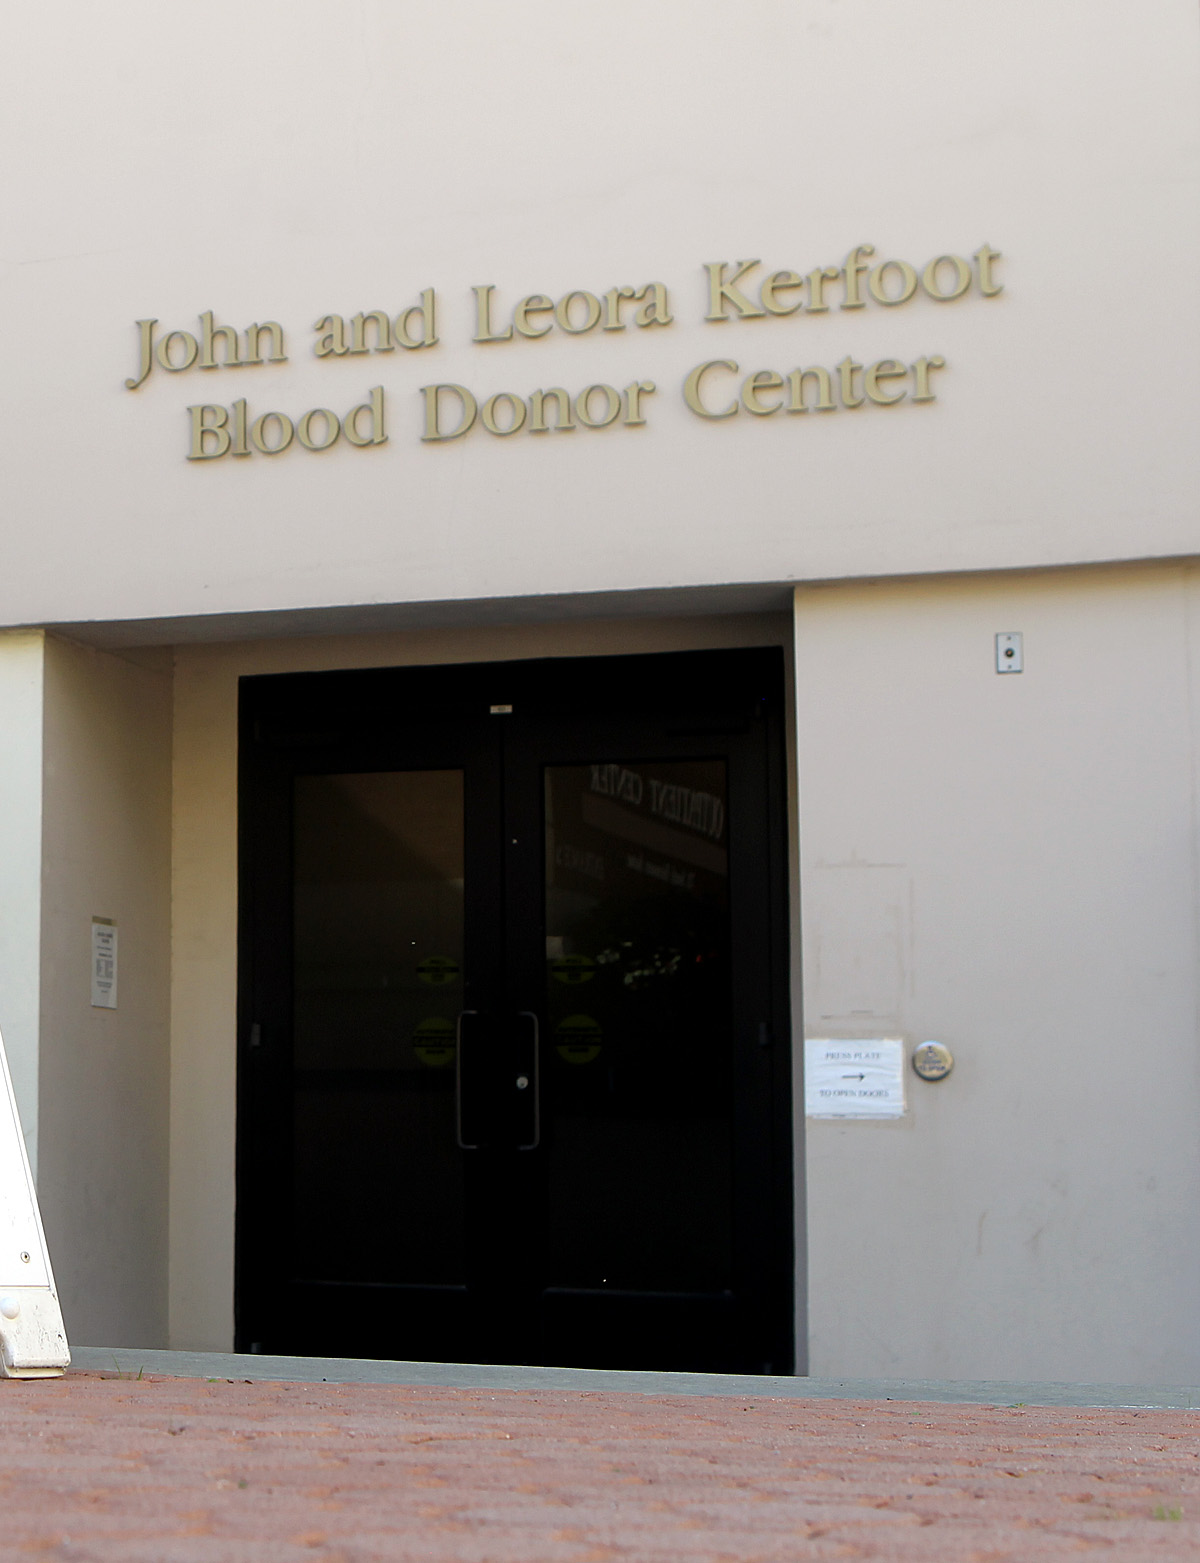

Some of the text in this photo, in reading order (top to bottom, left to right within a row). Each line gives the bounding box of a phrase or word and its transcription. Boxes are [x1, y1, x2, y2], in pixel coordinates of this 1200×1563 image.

[124, 242, 1003, 390] John and Leora Kerfoot
[186, 355, 945, 461] Blood Donor Center
[825, 1051, 881, 1060] PRESS PLATE
[819, 1089, 890, 1098] TO OPEN DOORS
